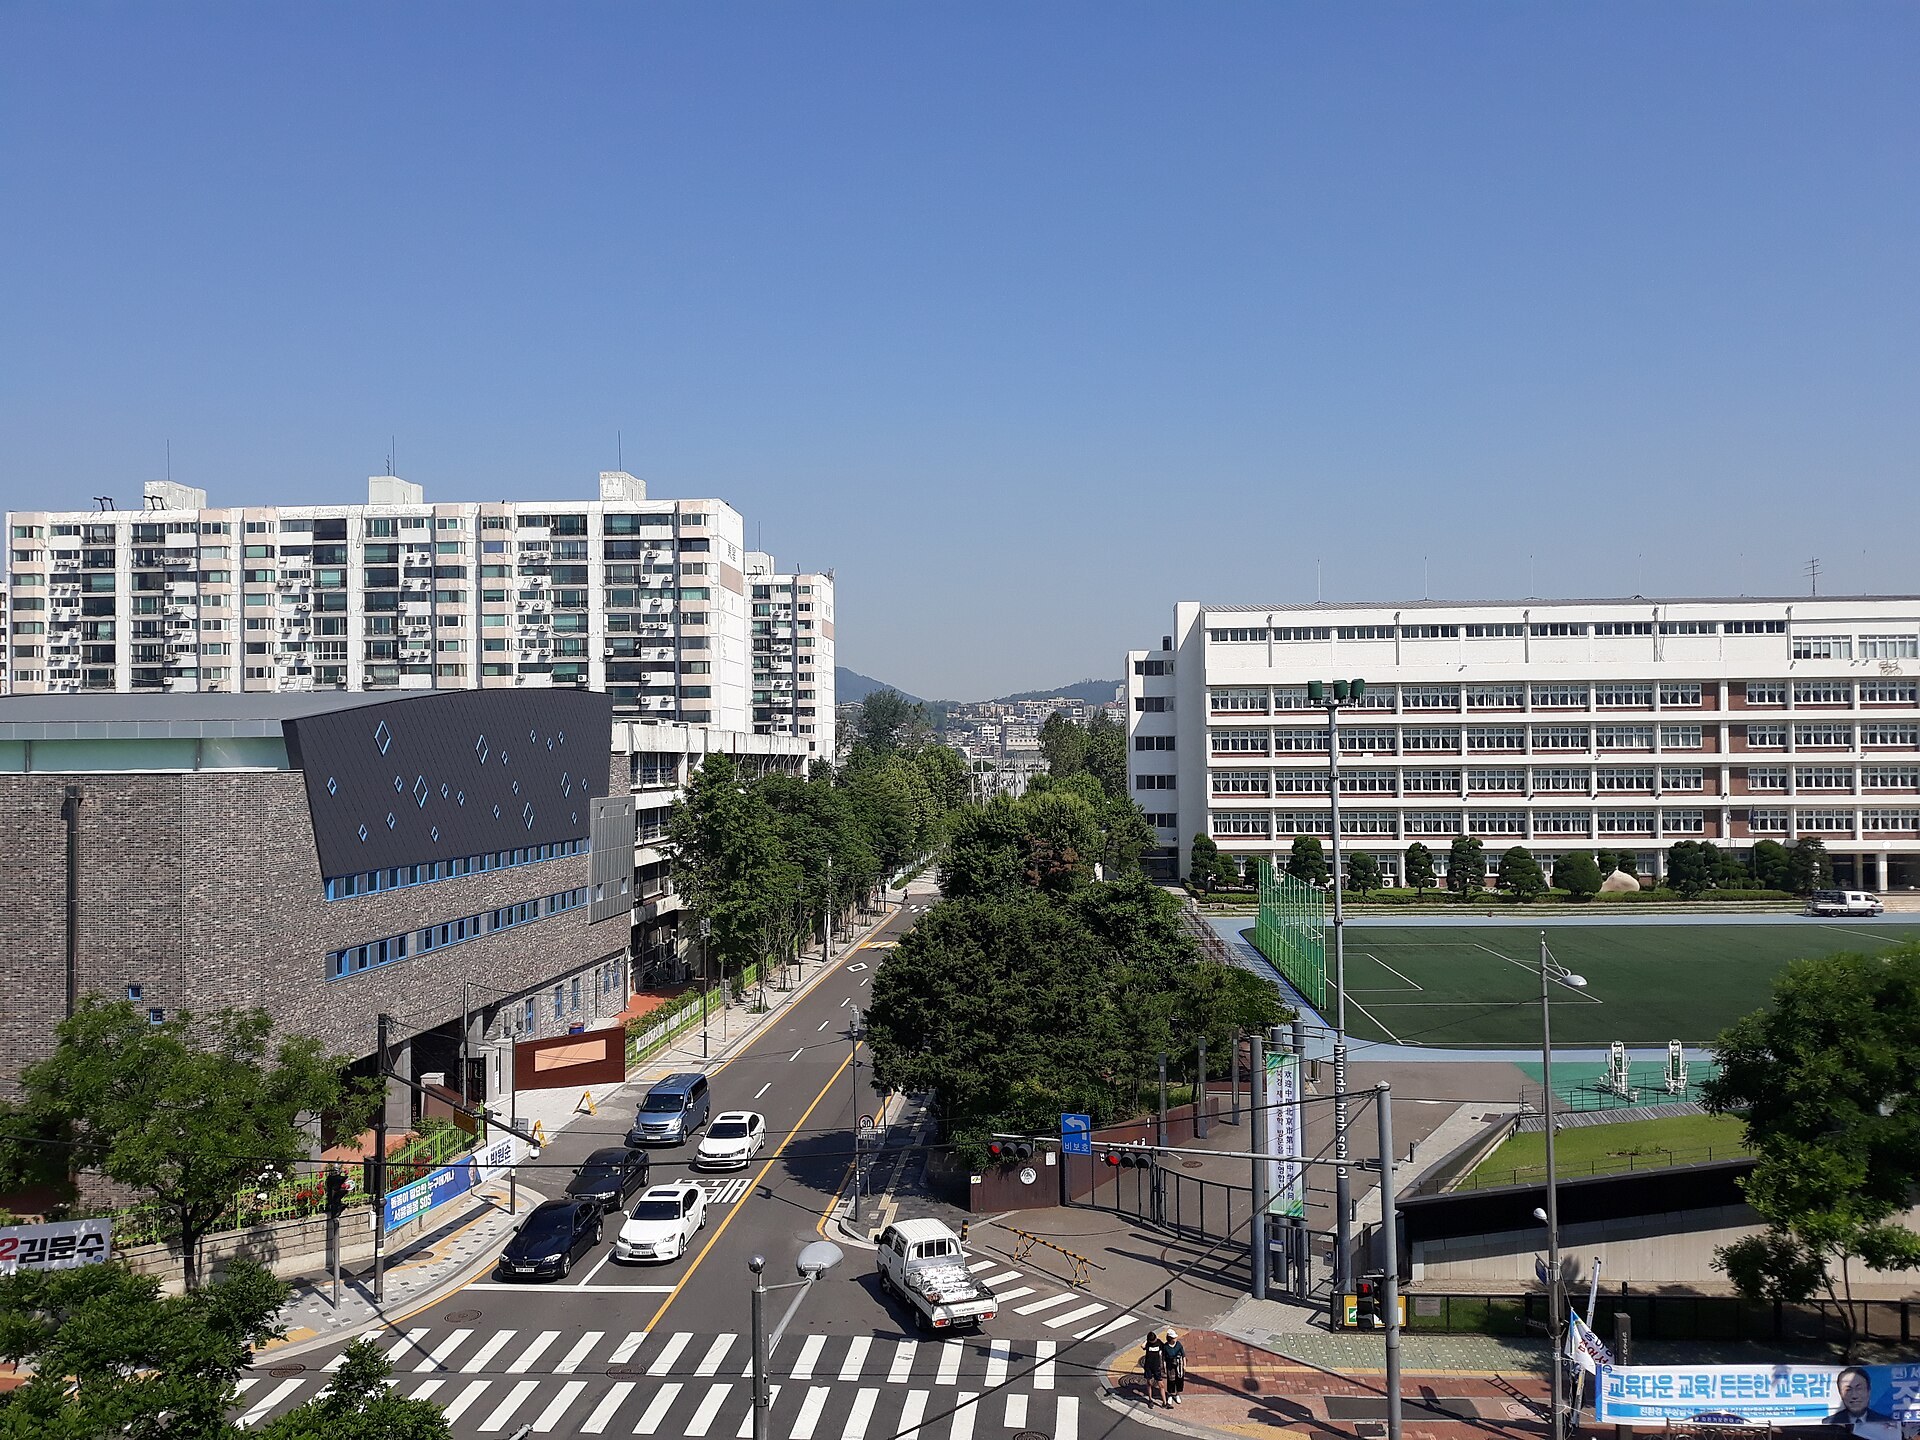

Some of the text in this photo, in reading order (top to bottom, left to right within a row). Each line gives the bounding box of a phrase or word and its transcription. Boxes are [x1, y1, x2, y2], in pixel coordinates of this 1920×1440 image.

[861, 1119, 872, 1128] 30
[1334, 1046, 1349, 1179] hyunda high schol
[490, 1143, 512, 1166] 박원순
[1064, 1142, 1090, 1153] 비보호
[1607, 1372, 1832, 1400] 교육다운 교육! 든든한 교육감!
